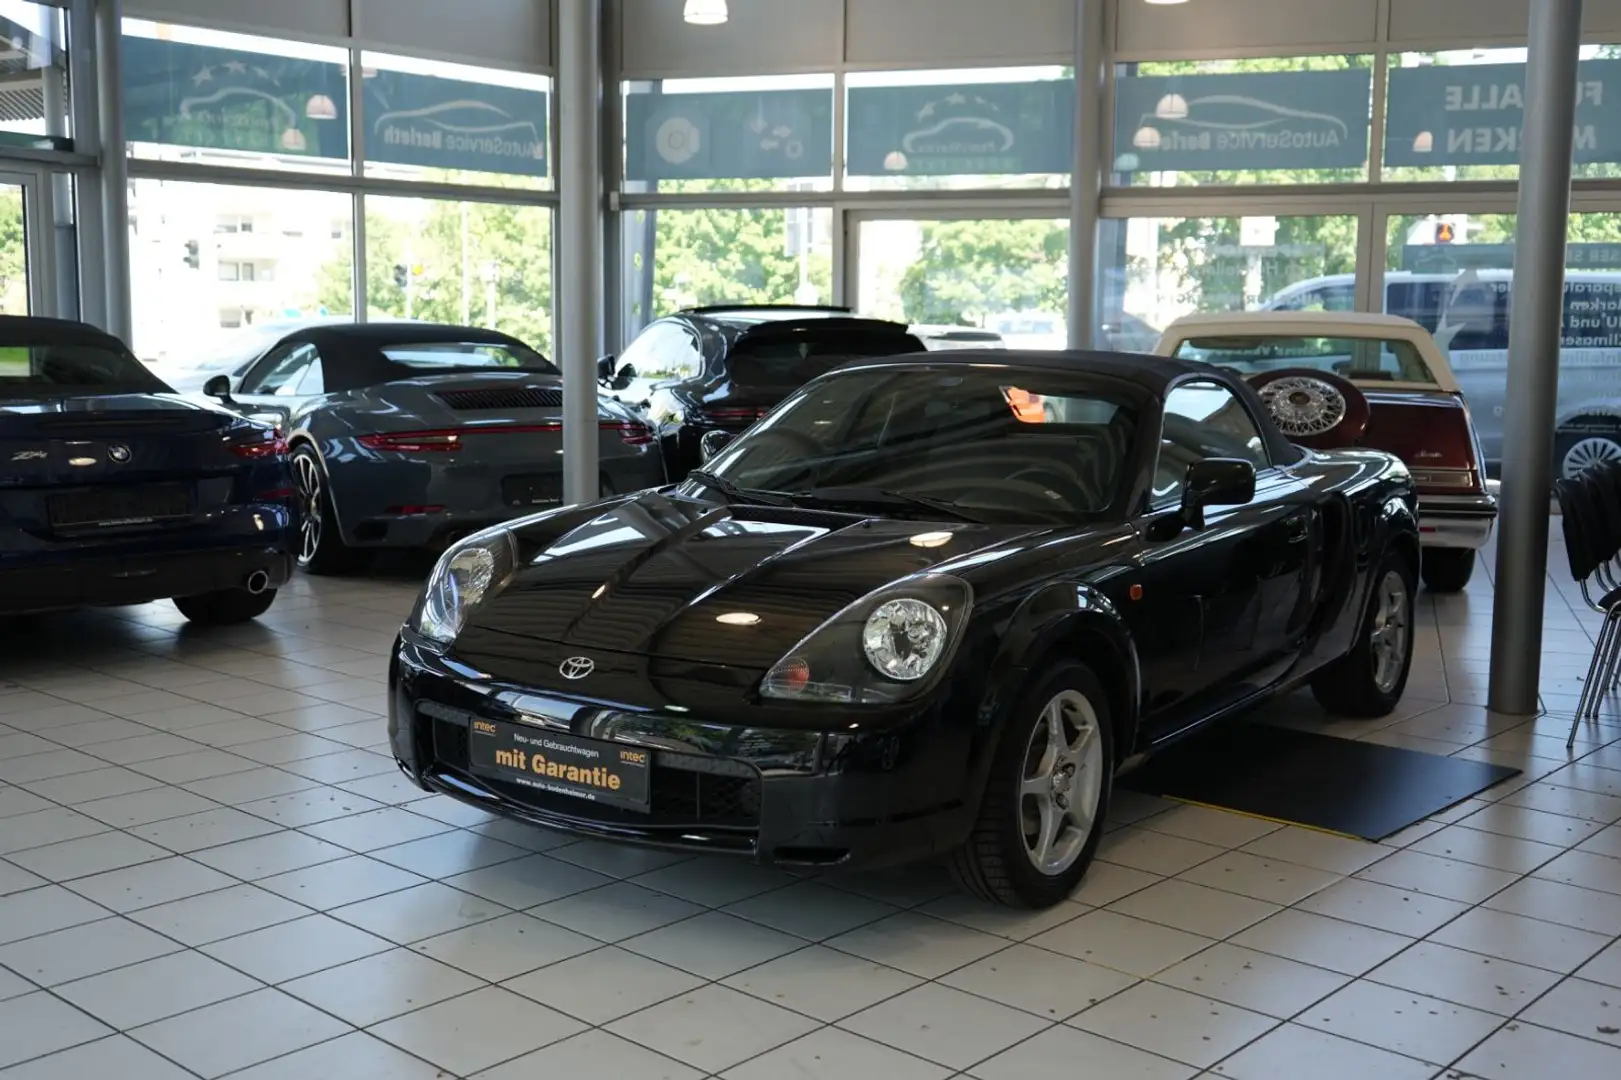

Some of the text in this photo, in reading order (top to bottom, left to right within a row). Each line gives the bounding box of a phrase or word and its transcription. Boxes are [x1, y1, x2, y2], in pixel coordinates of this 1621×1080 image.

[473, 720, 497, 733] intec
[513, 732, 600, 759] Neu- und Gebrauchtwagen
[619, 750, 646, 763] intec
[495, 749, 622, 790] mit Garantie
